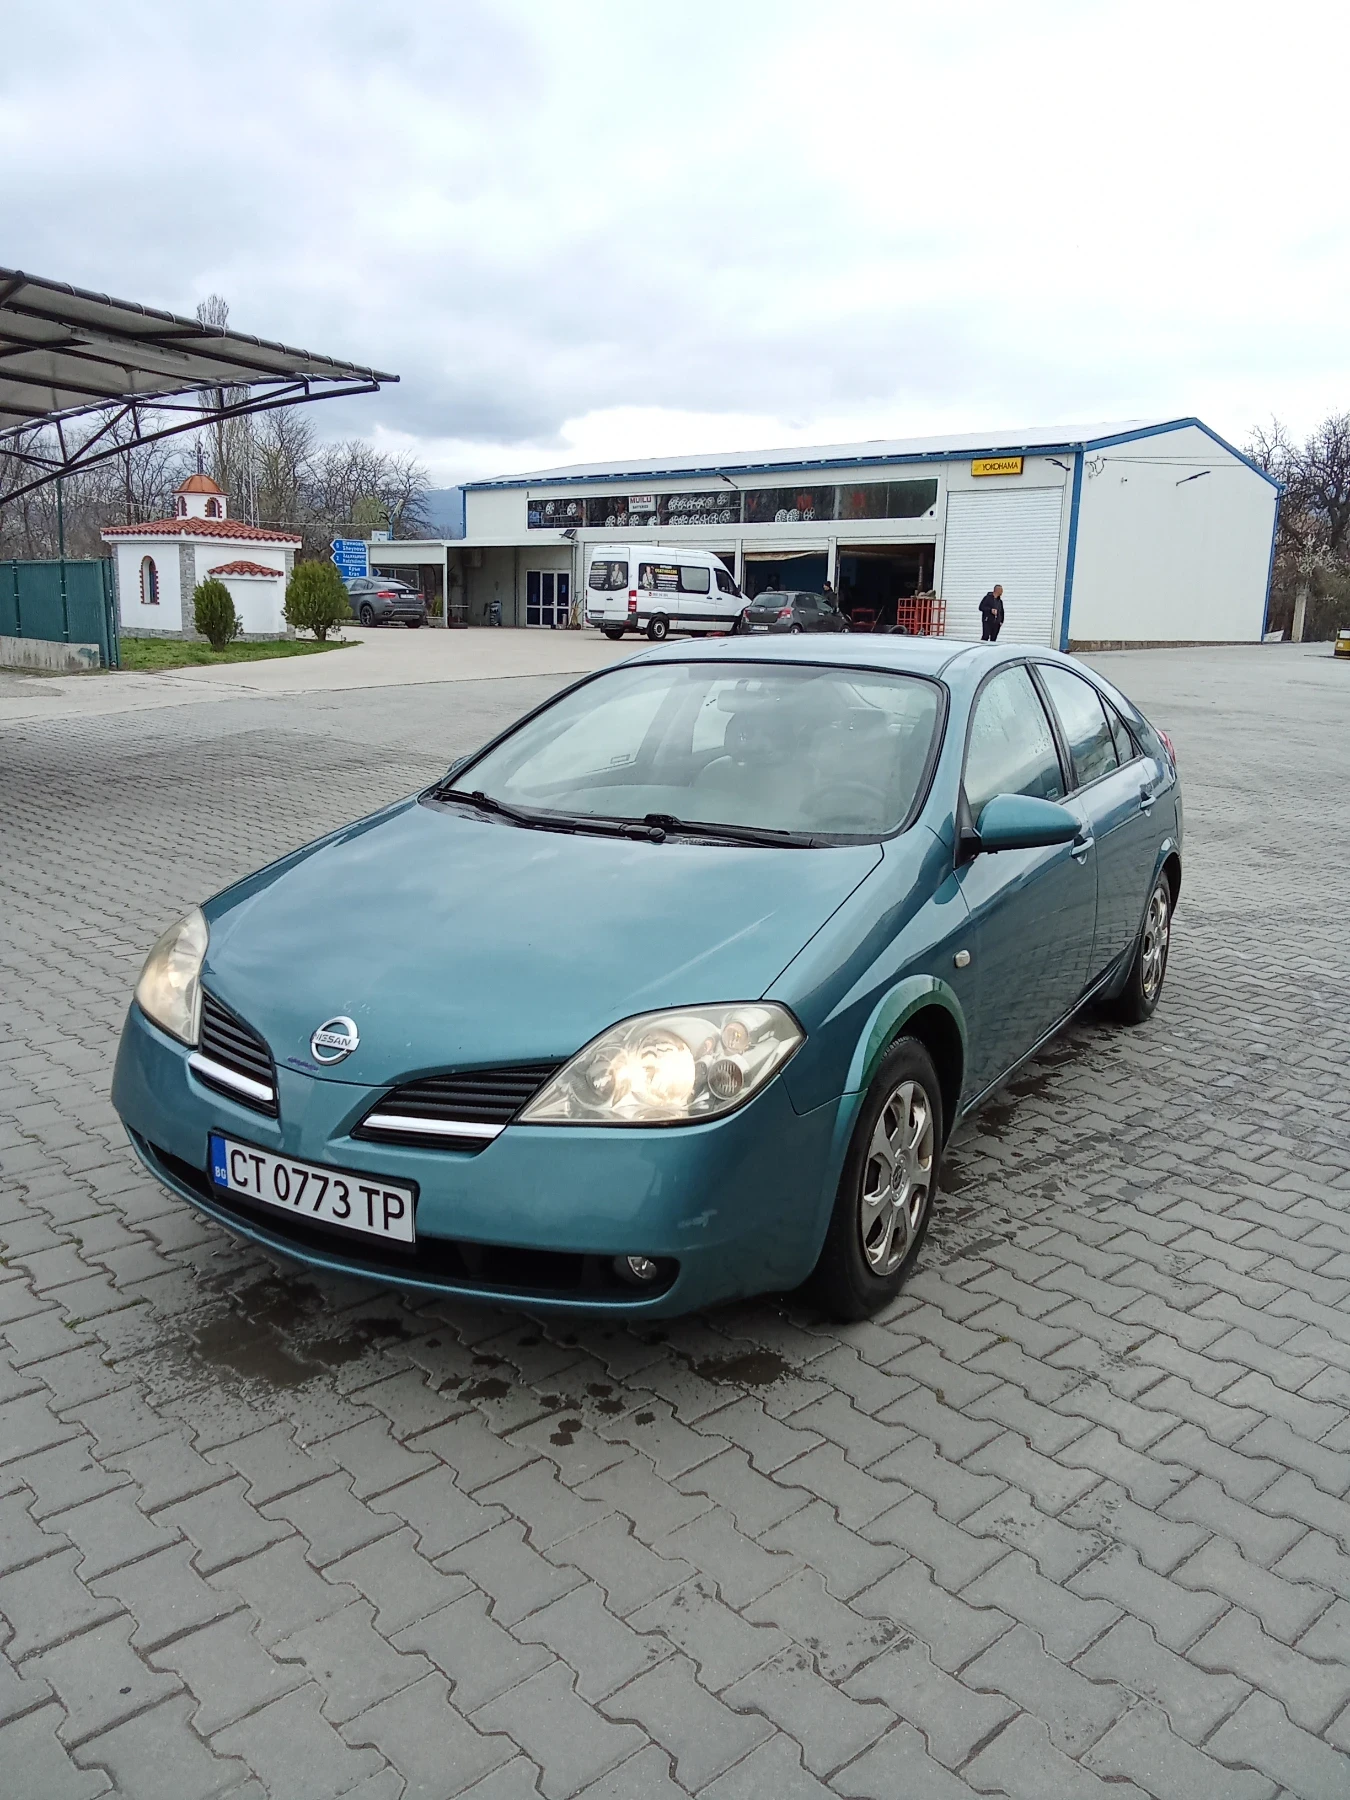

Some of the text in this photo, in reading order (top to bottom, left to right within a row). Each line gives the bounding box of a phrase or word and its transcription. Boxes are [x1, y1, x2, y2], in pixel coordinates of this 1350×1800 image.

[982, 461, 1019, 471] YOKOHAMA
[315, 1033, 352, 1047] NISSAN
[214, 1165, 227, 1180] BG
[273, 1163, 352, 1219] 0773
